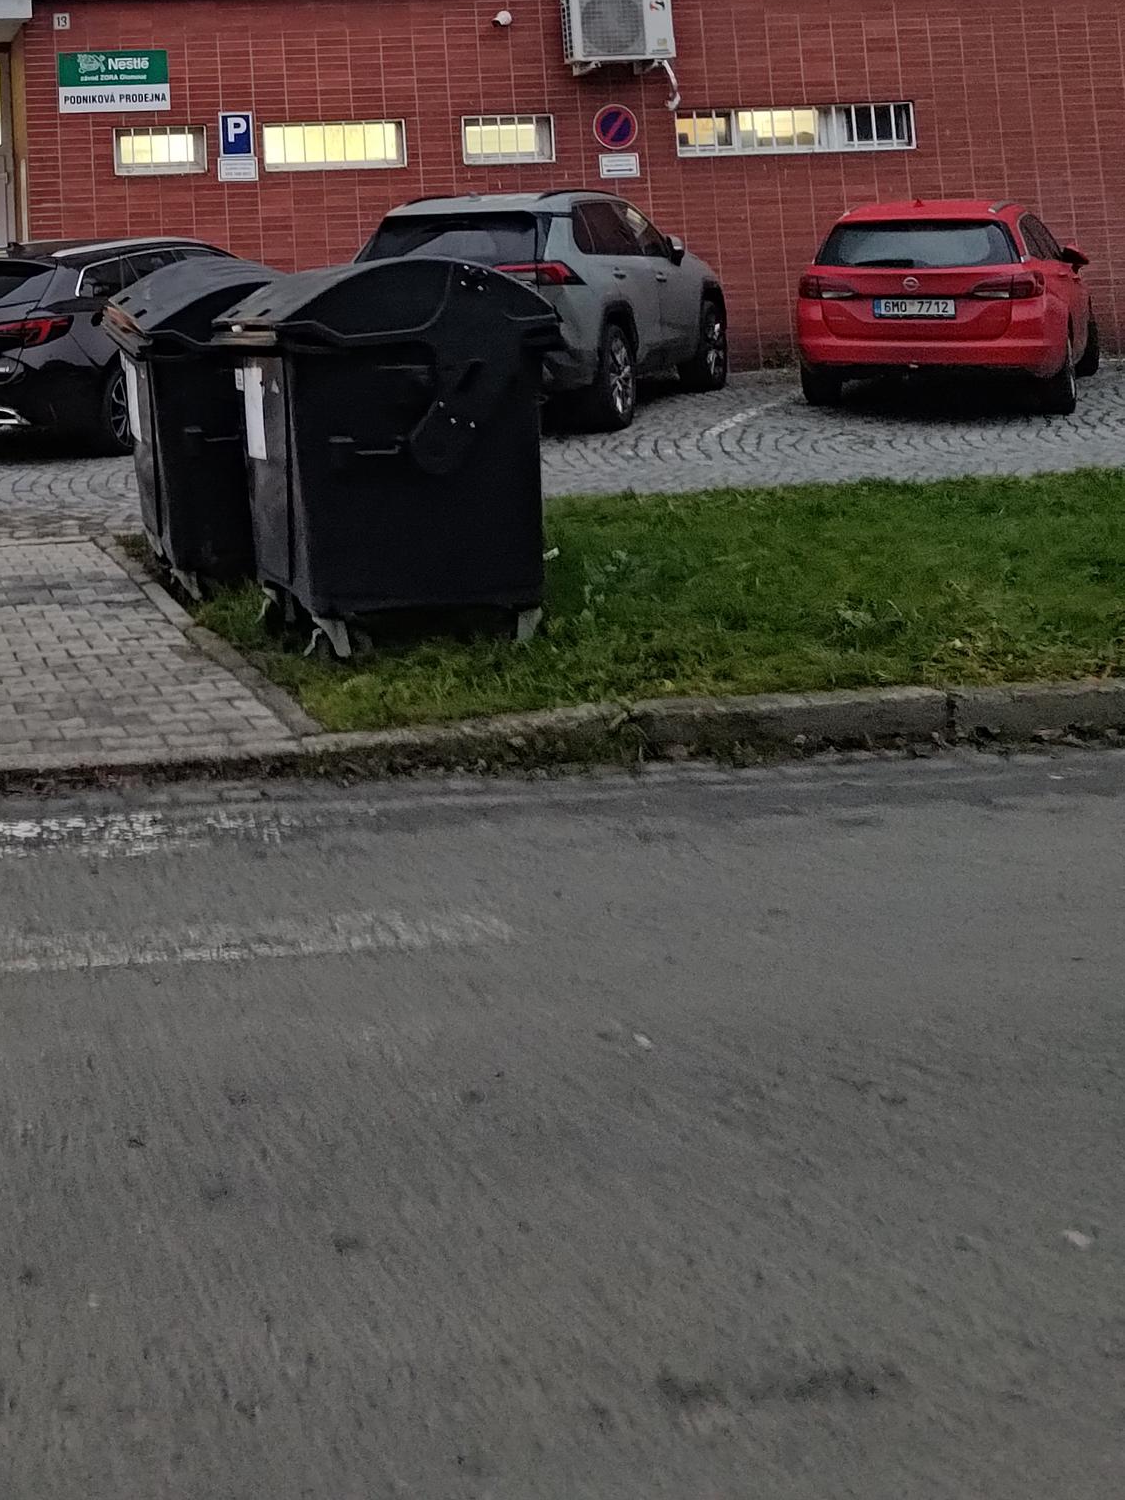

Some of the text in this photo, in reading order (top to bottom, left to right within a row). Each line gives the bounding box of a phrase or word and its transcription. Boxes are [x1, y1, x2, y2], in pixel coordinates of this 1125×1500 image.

[56, 16, 67, 27] 13
[107, 57, 150, 71] Nestlé
[63, 92, 167, 105] PODNIKOVÁ PRODEJNA
[227, 117, 247, 143] P
[917, 301, 948, 313] 7712
